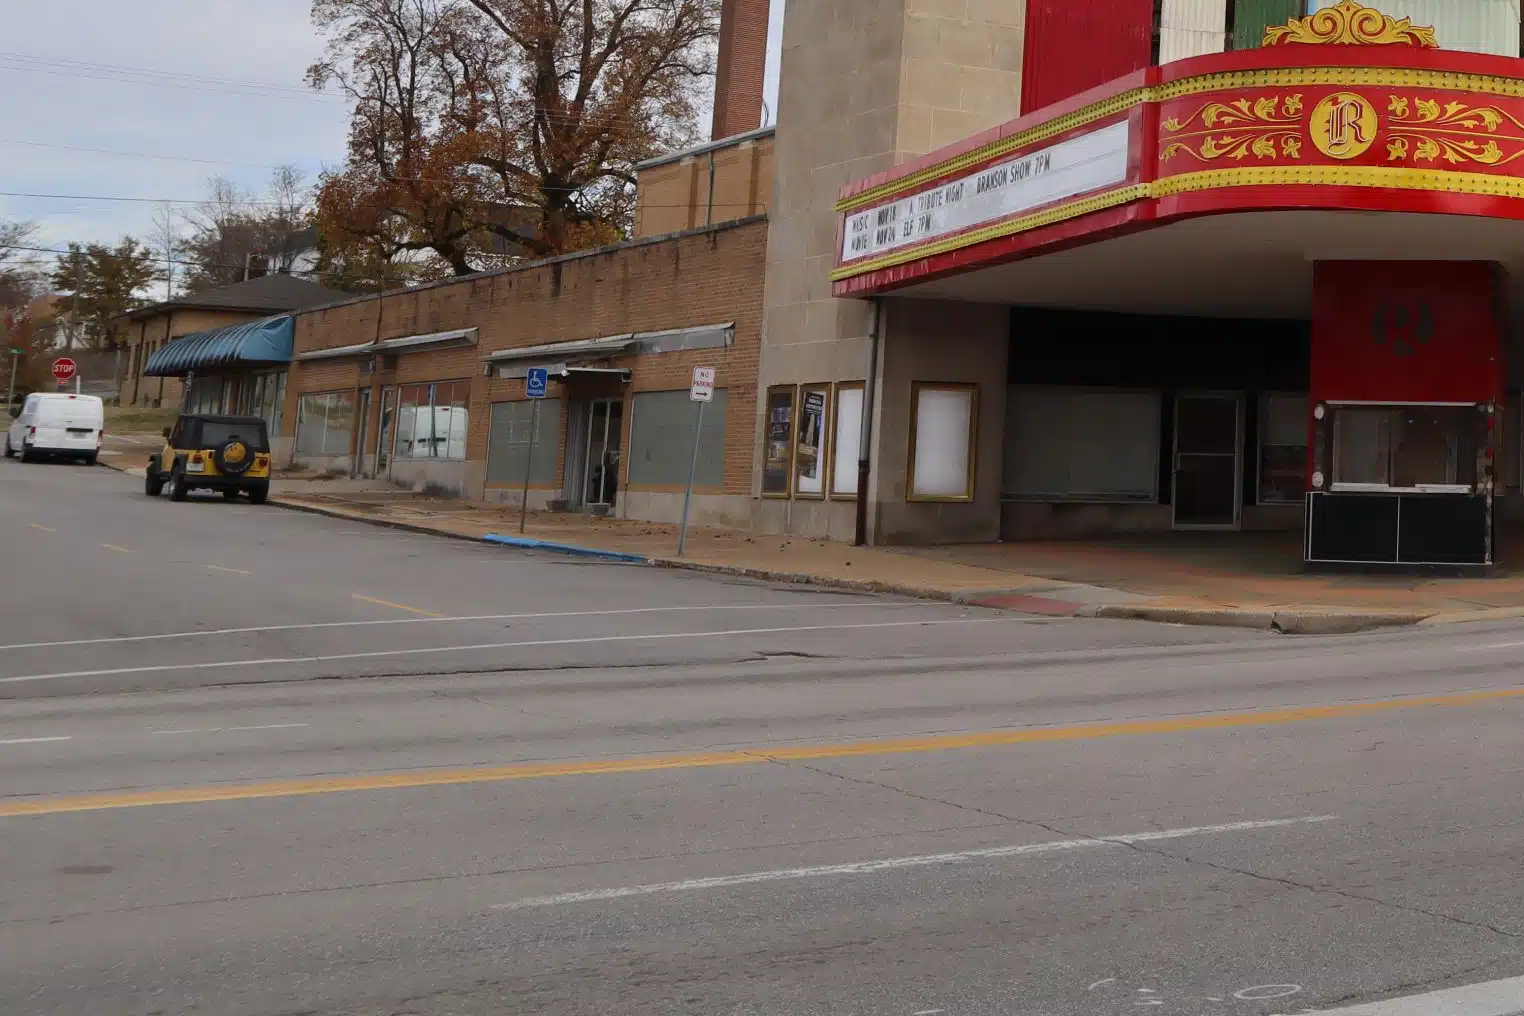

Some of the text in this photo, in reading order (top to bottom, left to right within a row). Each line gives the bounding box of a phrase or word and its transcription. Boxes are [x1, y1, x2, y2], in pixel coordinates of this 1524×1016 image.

[909, 199, 913, 215] A
[945, 182, 964, 203] NIGHT
[976, 168, 1008, 194] BRANSON
[1010, 159, 1032, 183] SHOW
[1034, 152, 1051, 176] 7PM
[903, 219, 914, 238] ELF
[918, 214, 931, 233] 7PM
[53, 364, 74, 373] STOP
